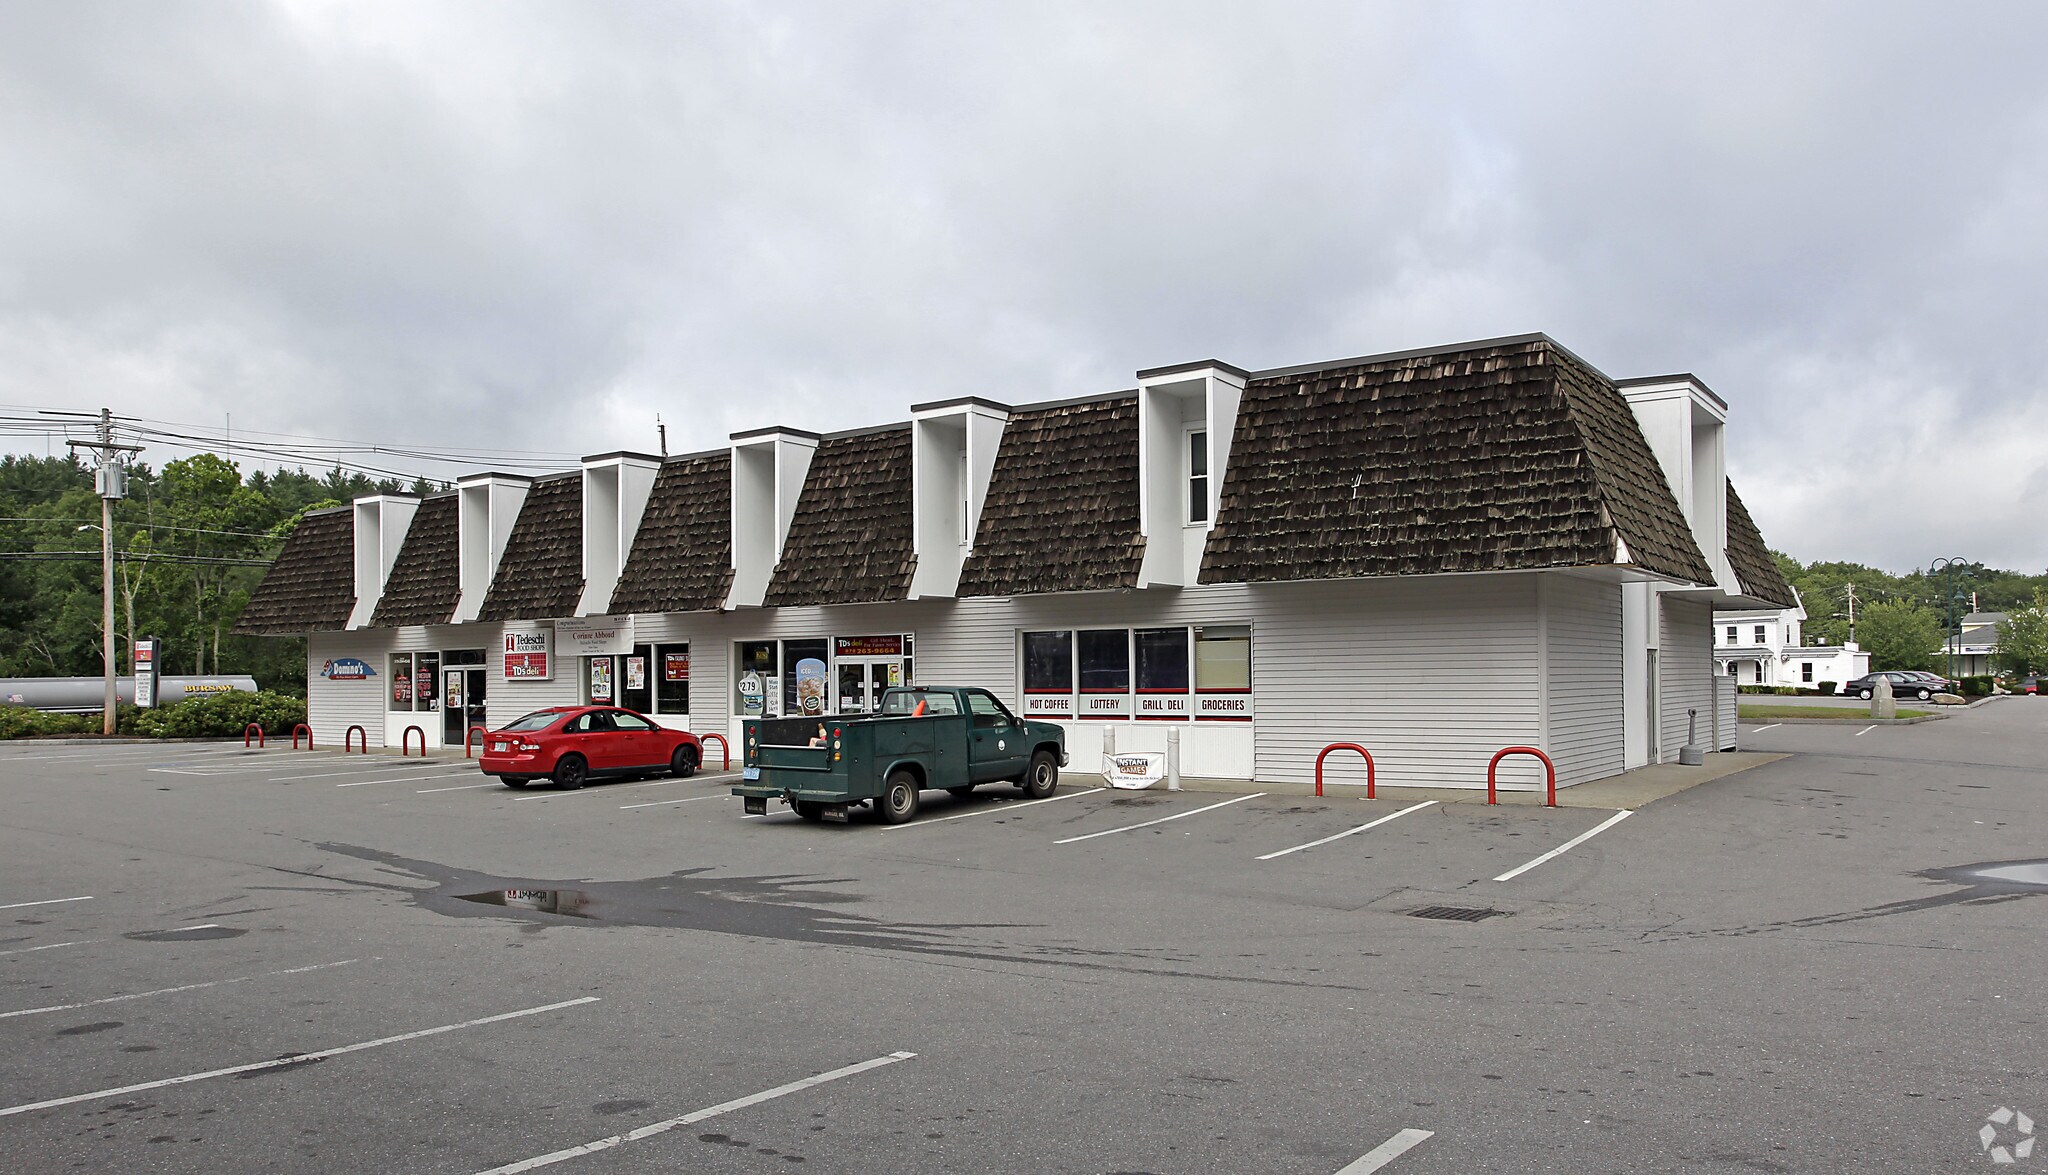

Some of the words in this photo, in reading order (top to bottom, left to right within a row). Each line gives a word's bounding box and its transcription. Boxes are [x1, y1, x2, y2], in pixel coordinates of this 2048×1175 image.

[516, 633, 545, 645] Tedeschi
[851, 639, 863, 647] deli
[333, 662, 363, 675] Domino's
[526, 666, 539, 676] deli
[739, 681, 756, 692] $2.79
[1030, 700, 1042, 709] HOT
[1044, 700, 1069, 709] COFFEE
[1090, 699, 1120, 710] LOTTERY
[1142, 700, 1164, 710] GRILL
[1167, 700, 1184, 710] DELI
[1202, 699, 1245, 711] GROCERIES
[1117, 759, 1147, 767] INSTANT
[1121, 766, 1146, 774] GAMES
